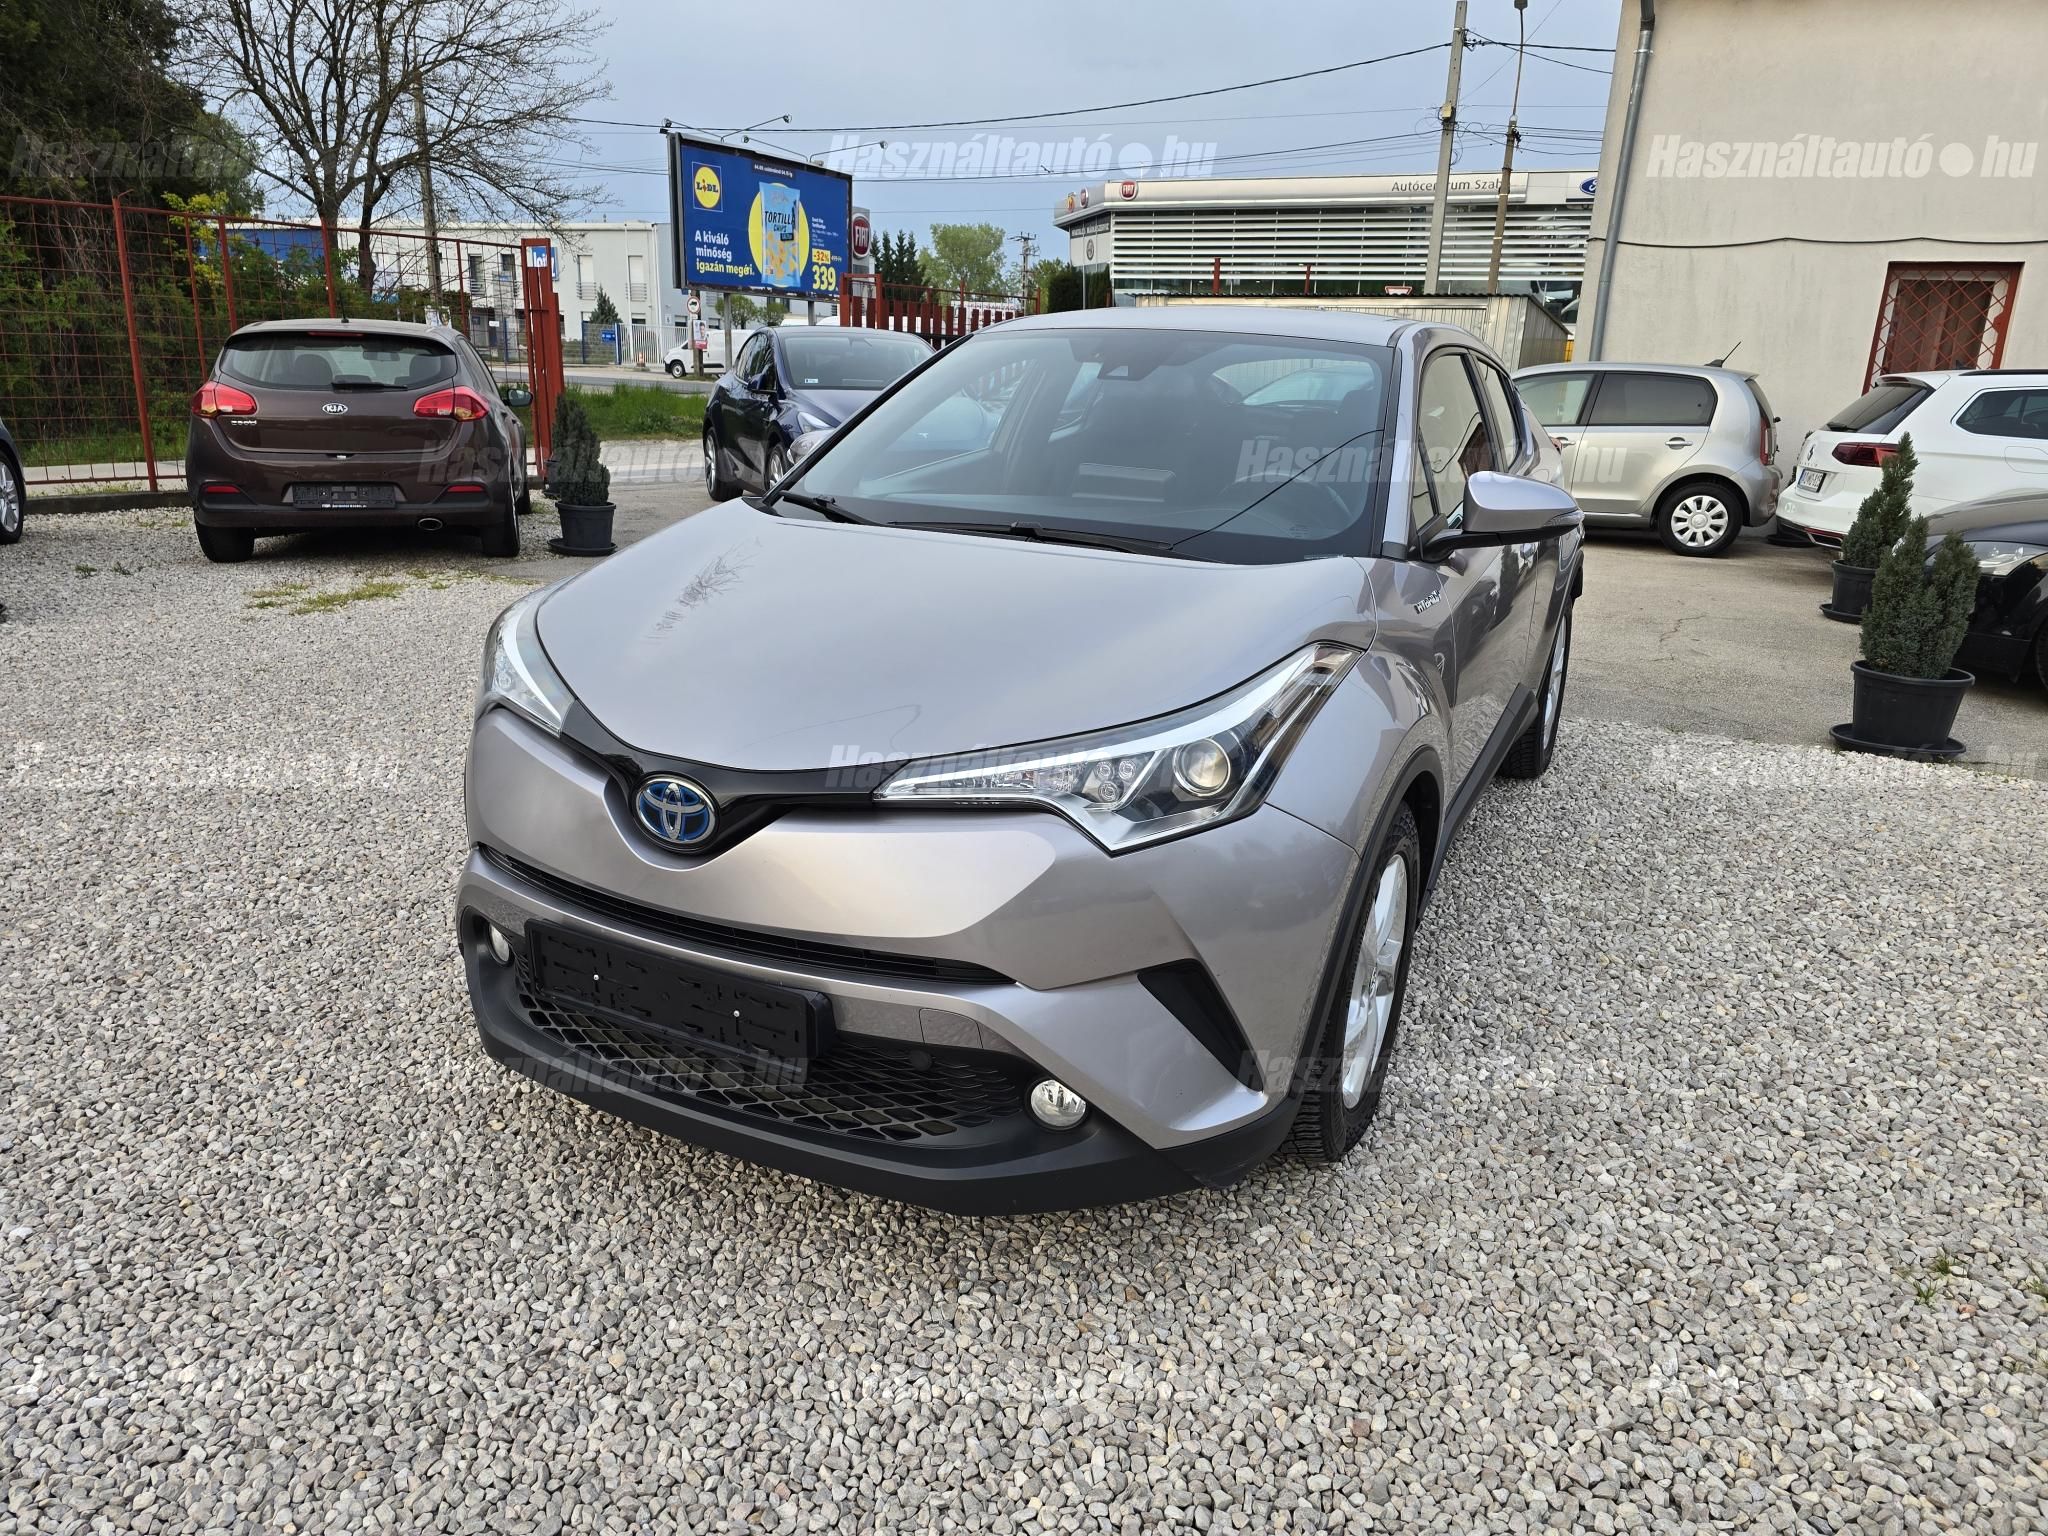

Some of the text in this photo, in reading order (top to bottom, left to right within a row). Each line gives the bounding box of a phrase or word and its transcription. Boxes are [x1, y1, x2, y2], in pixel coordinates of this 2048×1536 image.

[764, 210, 796, 227] TORTILLA
[695, 229, 730, 246] A kiváló
[855, 225, 869, 248] FIAT
[696, 244, 732, 262] minőség
[696, 258, 725, 274] igazán
[812, 264, 837, 291] 339
